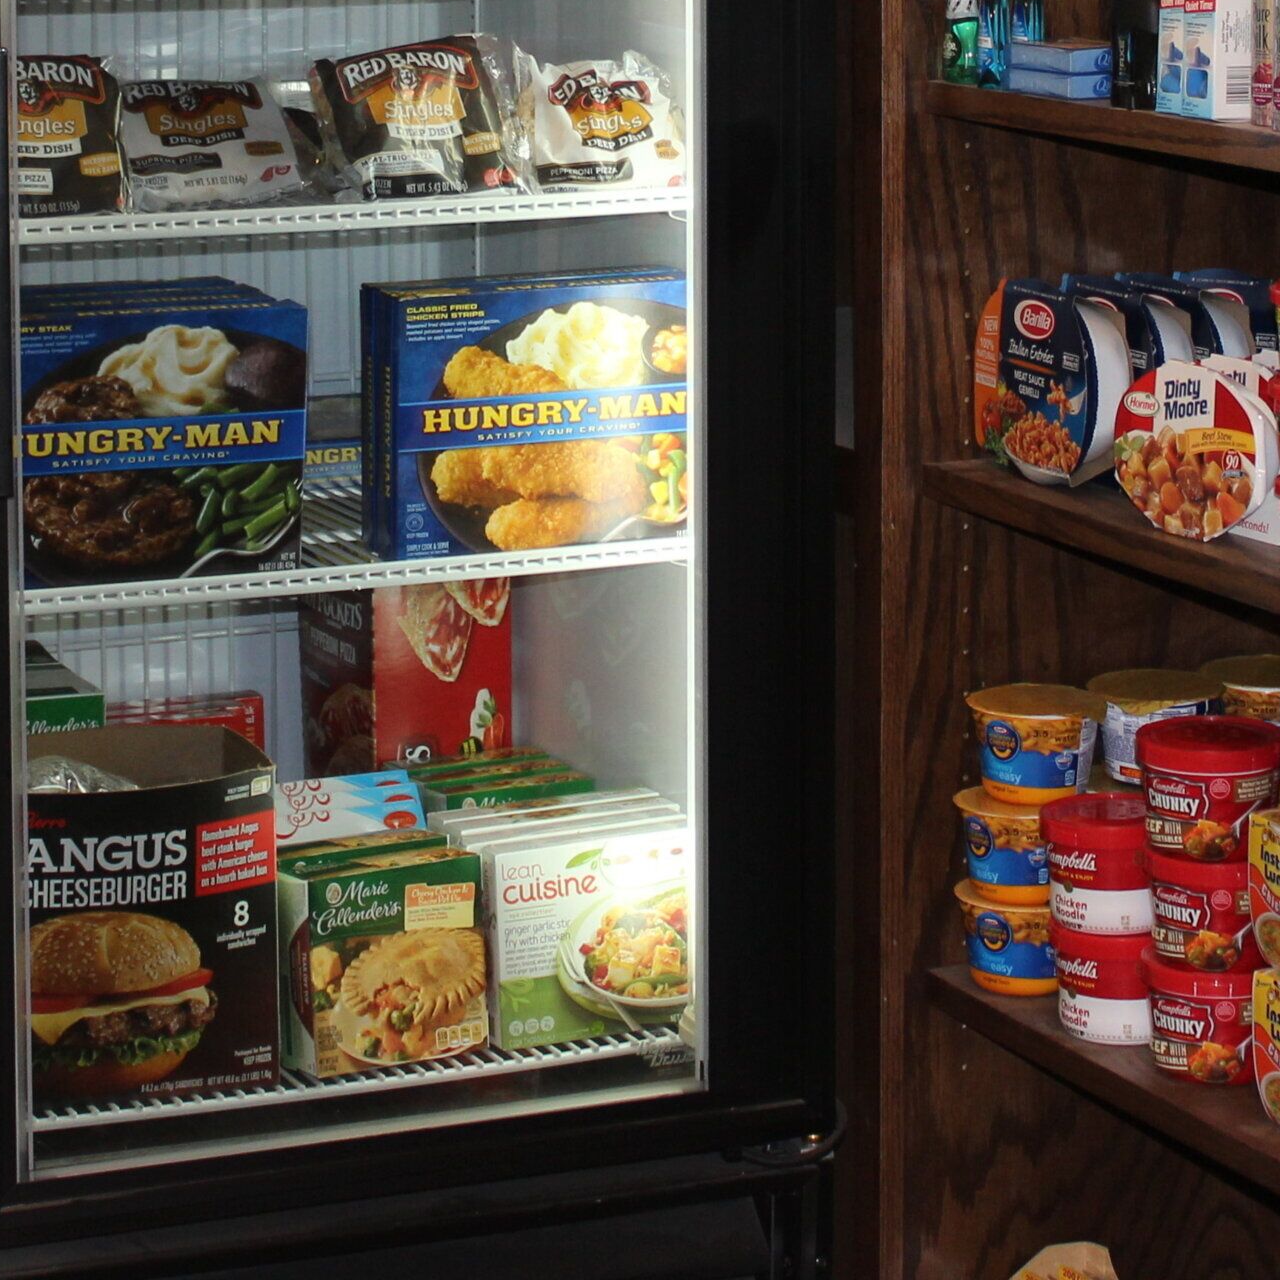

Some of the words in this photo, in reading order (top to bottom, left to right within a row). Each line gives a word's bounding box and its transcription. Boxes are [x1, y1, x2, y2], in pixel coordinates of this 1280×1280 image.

[1185, 0, 1199, 11] Quiet
[1199, 0, 1214, 10] Time
[17, 60, 94, 89] BARON
[343, 58, 387, 89] RED
[384, 51, 466, 76] BARON
[126, 82, 166, 104] RED
[383, 100, 455, 120] Singles
[159, 113, 238, 133] Singles
[169, 135, 203, 146] DEEP
[206, 130, 238, 144] DISH
[585, 136, 618, 150] DEEP
[43, 143, 74, 154] DISH
[25, 174, 47, 183] PIZZA
[550, 166, 594, 177] PEPPERONI
[595, 166, 619, 176] PIZZA
[406, 312, 448, 322] CHICKEN
[451, 310, 485, 319] STRIPS
[407, 305, 447, 314] CLASSIC
[450, 303, 478, 311] FRIED
[1022, 307, 1052, 331] Barilla
[1013, 369, 1028, 382] MEAT
[1028, 371, 1046, 388] SAUCE
[1165, 378, 1201, 400] Dinty
[422, 391, 687, 434] HUNGRY-MAN
[1129, 395, 1156, 412] Hormel
[1164, 399, 1208, 421] Moore
[477, 428, 532, 442] SATISFY
[539, 426, 573, 437] YOUR
[53, 457, 111, 468] SATISFY
[119, 455, 155, 465] YOUR
[1225, 454, 1239, 469] 90
[1148, 789, 1200, 817] CHUNKY
[24, 828, 188, 874] ANGUS
[501, 861, 545, 881] lean
[339, 880, 389, 907] Marie
[502, 872, 598, 905] cuisine
[1055, 894, 1088, 911] Chicken
[1153, 896, 1201, 928] CHUNKY
[233, 900, 250, 927] 8
[312, 898, 402, 936] Callender's
[1056, 906, 1086, 921] Noodle
[504, 923, 531, 937] ginger
[531, 920, 556, 934] garlic
[504, 935, 519, 948] fry
[519, 934, 539, 946] with
[539, 930, 571, 945] chicken
[1061, 999, 1090, 1018] Chicken
[1153, 1009, 1205, 1040] CHUNKY
